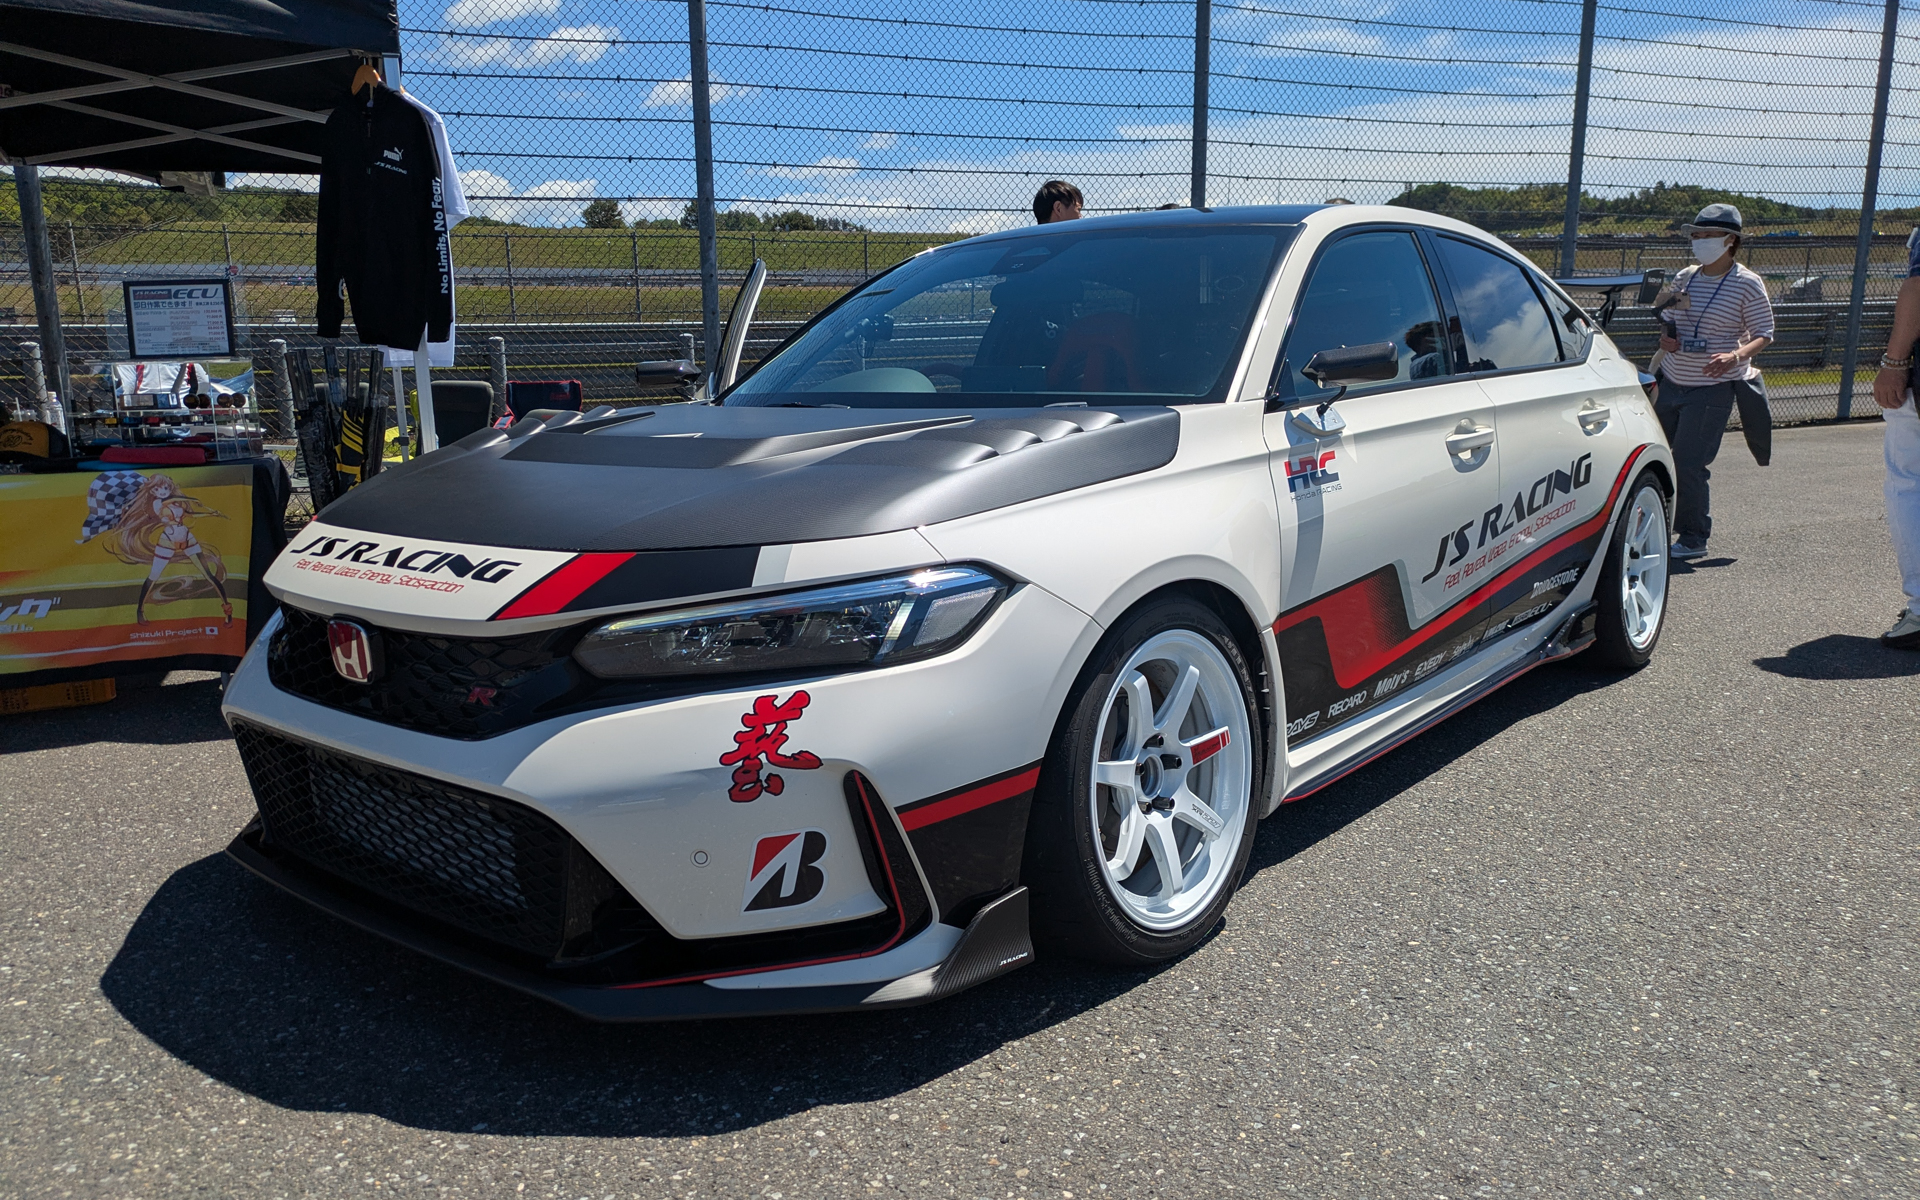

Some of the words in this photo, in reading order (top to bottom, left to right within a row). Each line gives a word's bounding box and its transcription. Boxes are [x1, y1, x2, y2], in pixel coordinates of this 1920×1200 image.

[434, 211, 446, 231] No
[436, 233, 448, 272] Limits,
[173, 288, 219, 299] ECU
[441, 274, 449, 294] No
[1317, 483, 1343, 496] RACING
[1421, 520, 1474, 584] J'S
[1477, 452, 1592, 549] RACING
[290, 536, 350, 557] J'S
[334, 541, 523, 584] RACING
[1530, 567, 1580, 599] BRIDGESTONE
[129, 630, 164, 639] Shizuki
[165, 627, 204, 637] Project
[1414, 650, 1447, 676] EXEDY
[1373, 669, 1410, 697] Moty's
[1327, 690, 1368, 719] RECARO
